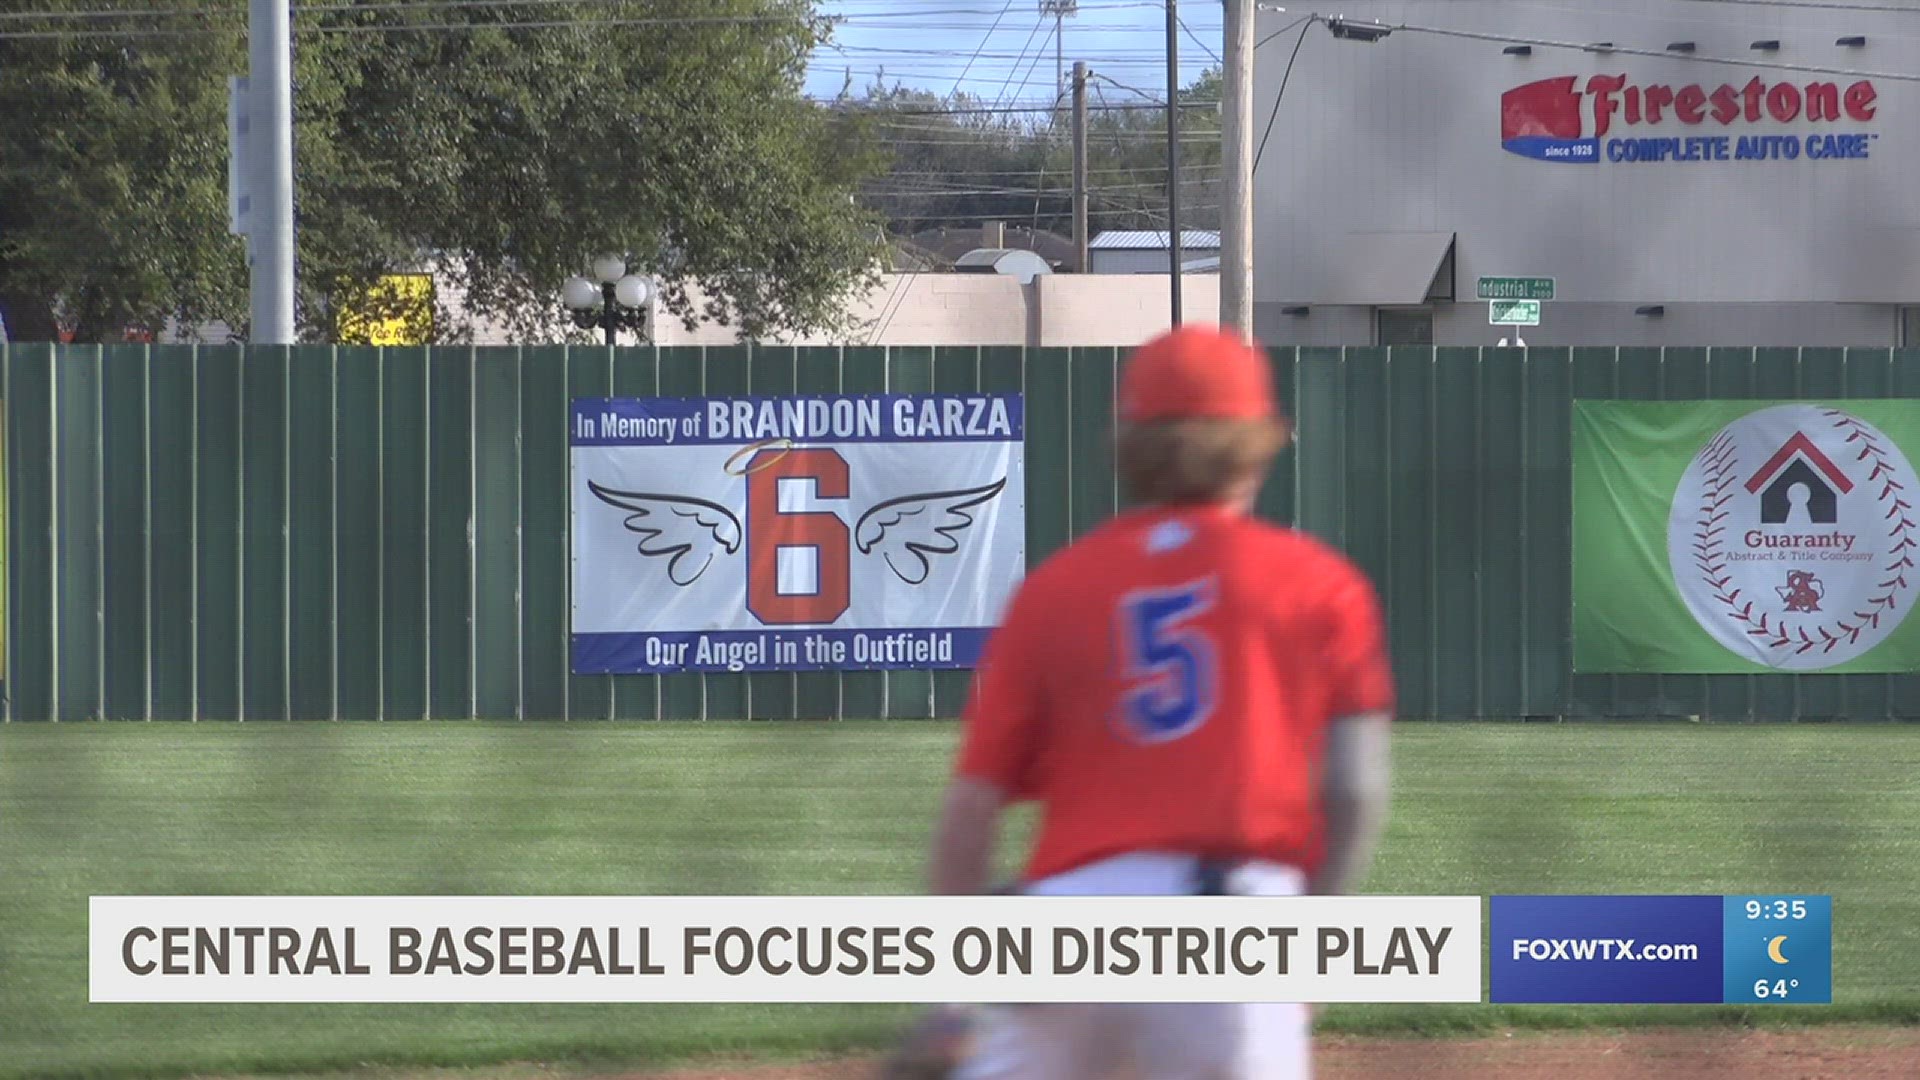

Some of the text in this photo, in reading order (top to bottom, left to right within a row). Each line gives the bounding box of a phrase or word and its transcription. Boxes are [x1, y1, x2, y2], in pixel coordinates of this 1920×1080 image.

[1586, 73, 1878, 136] Firestone
[1545, 146, 1569, 157] since
[1606, 138, 1728, 162] COMPLETE
[1735, 136, 1799, 161] AUTO
[1479, 280, 1528, 297] Industrial
[577, 398, 1012, 442] In Memory of BRANDON GARZA
[745, 448, 851, 626] 6
[1744, 529, 1856, 552] Guaranty
[1725, 550, 1875, 562] Abstract & Title Company
[645, 631, 952, 672] Our Angel in the Outfield
[1116, 578, 1222, 744] 5
